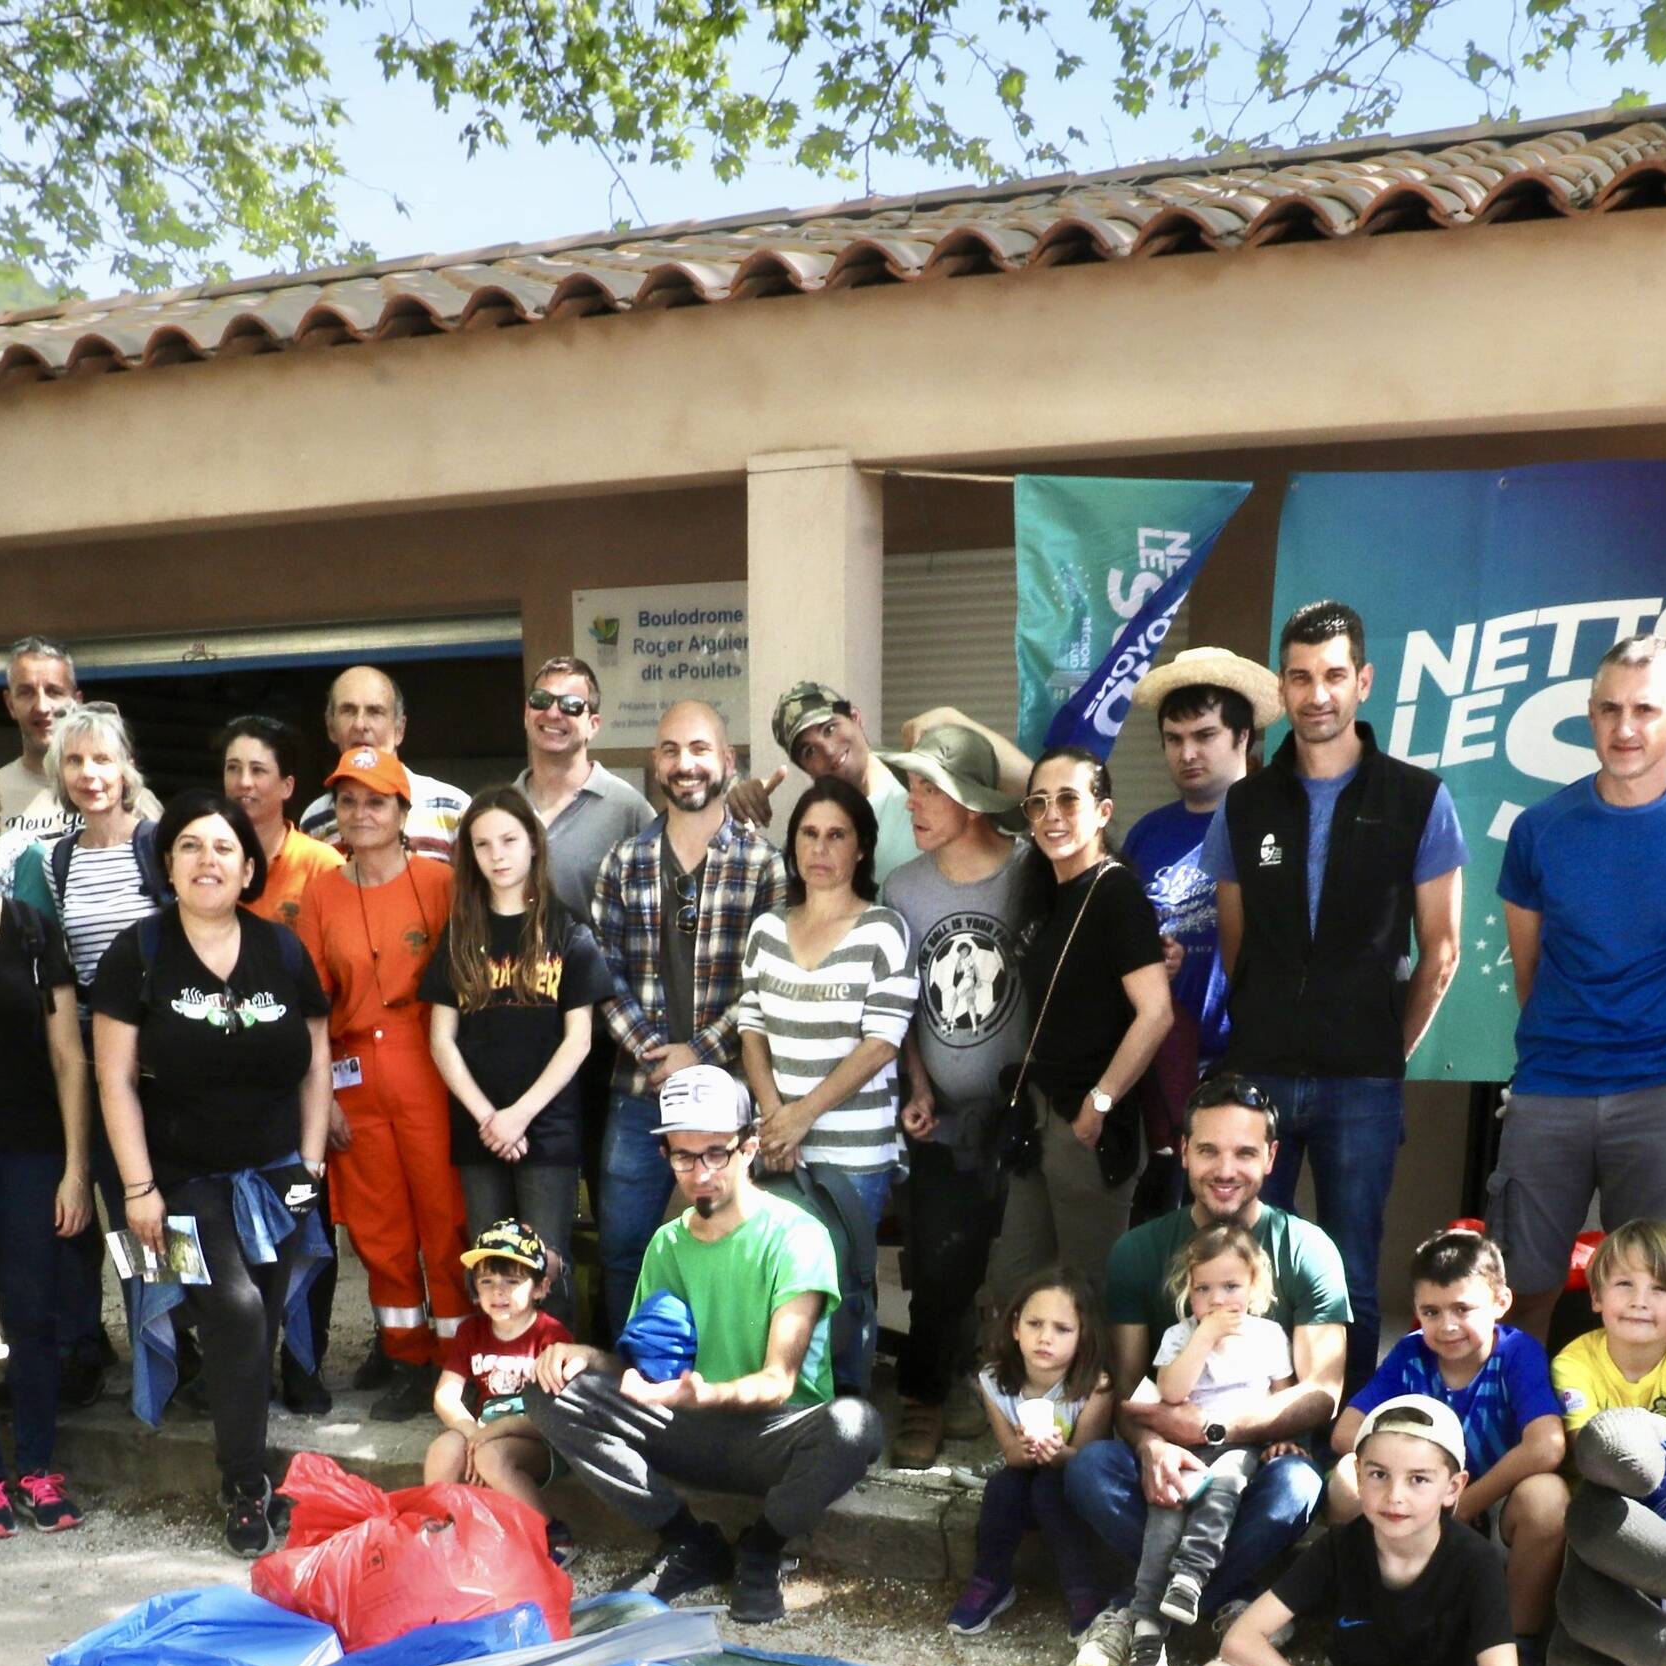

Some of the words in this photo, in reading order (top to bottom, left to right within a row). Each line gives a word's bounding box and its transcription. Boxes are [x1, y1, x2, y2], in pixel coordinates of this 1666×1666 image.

[638, 608, 743, 628] Boulodrome
[633, 637, 684, 658] Roger
[688, 634, 749, 656] Aiguier
[641, 664, 664, 682] dit
[668, 661, 743, 681] «Poulet»
[1387, 687, 1504, 770] LE
[5, 814, 53, 831] New
